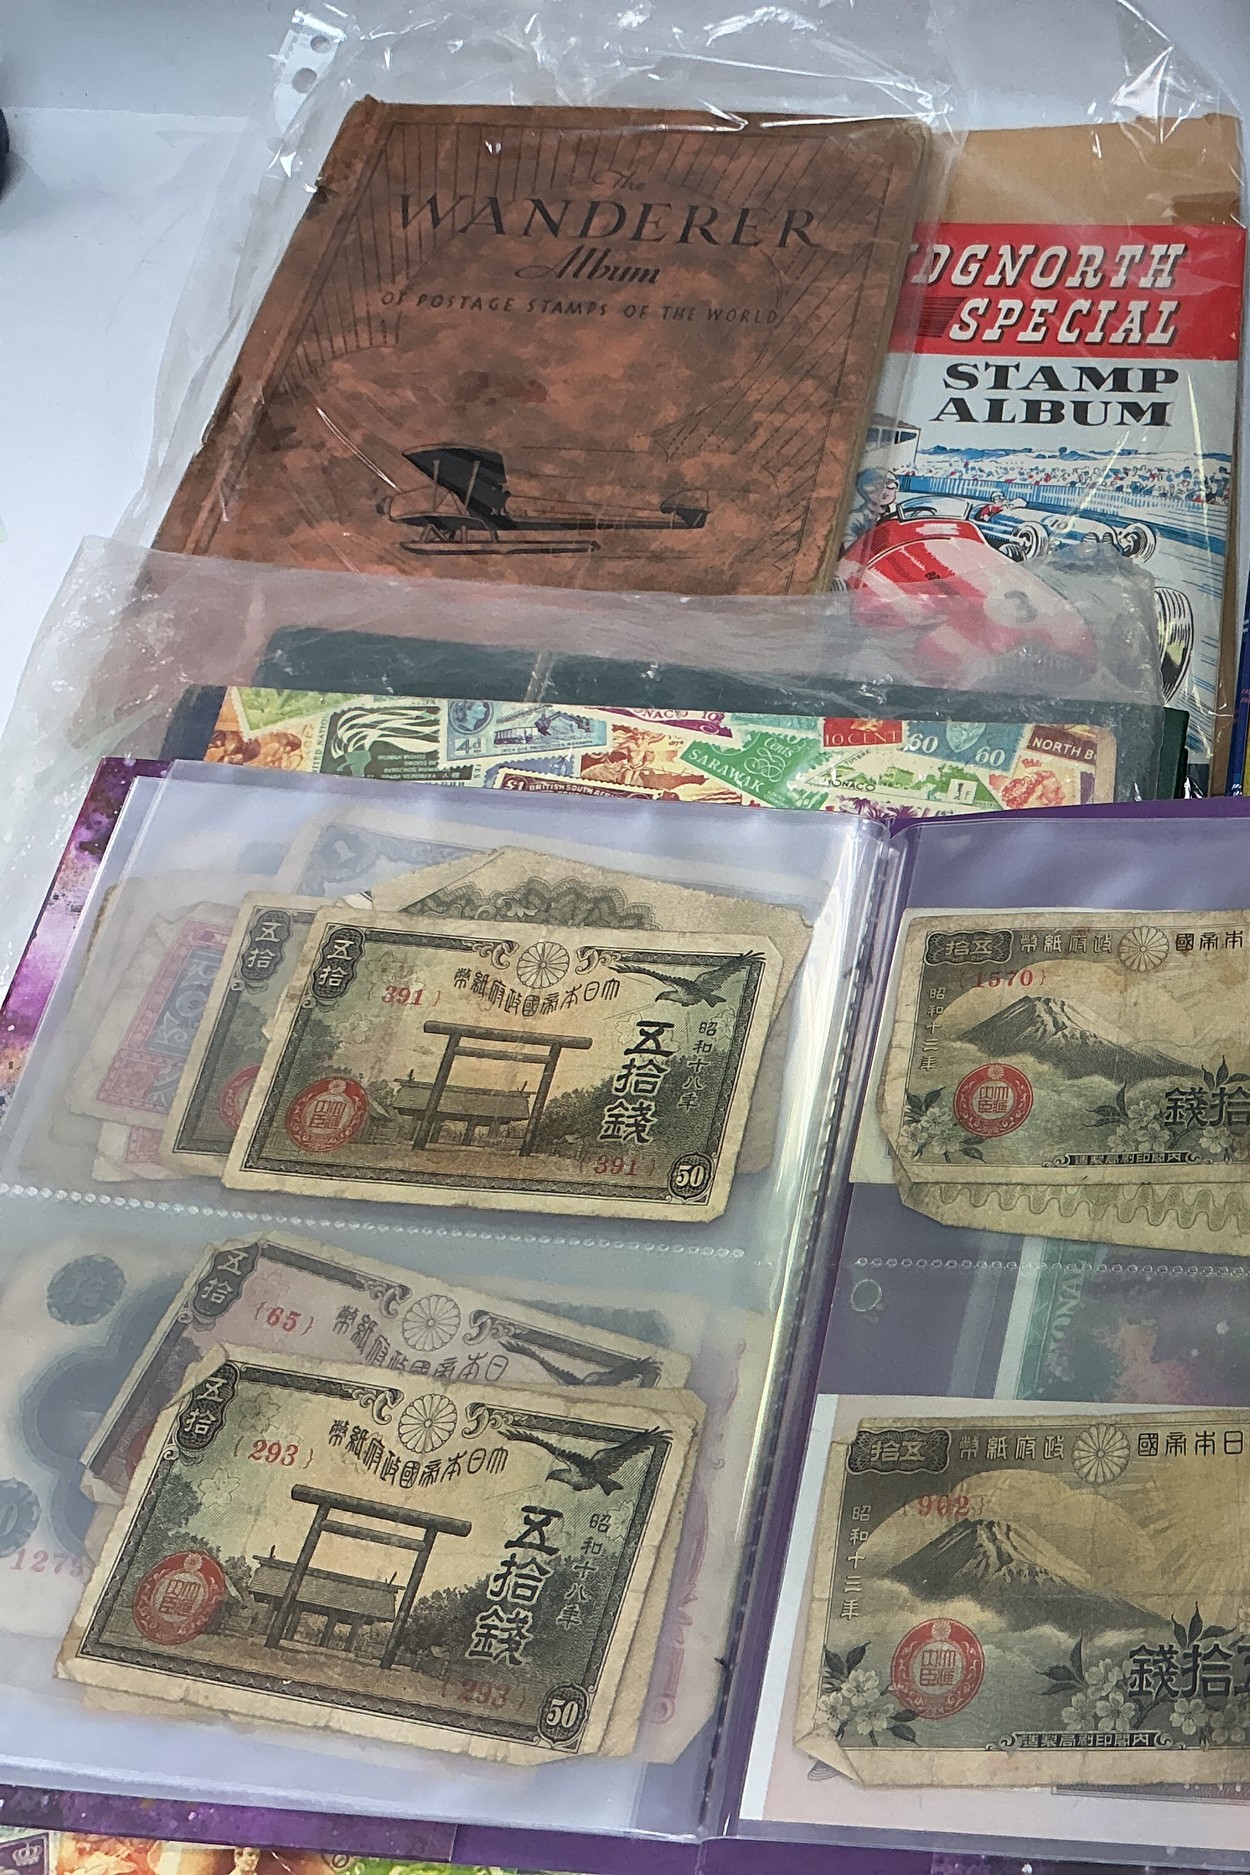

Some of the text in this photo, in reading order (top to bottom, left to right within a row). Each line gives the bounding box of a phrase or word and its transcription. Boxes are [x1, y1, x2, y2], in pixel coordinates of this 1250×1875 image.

[592, 170, 647, 193] The
[399, 194, 821, 248] WANDERER
[514, 245, 660, 285] Album
[381, 292, 780, 326] OF POSTAGE STAMPS OF THE WORLD
[949, 298, 1180, 345] SPECIAL
[942, 362, 1179, 394] STAMP
[930, 397, 1175, 427] ALBUM
[764, 737, 795, 758] Cents
[826, 734, 844, 746] 10
[908, 733, 939, 753] 60
[1032, 737, 1082, 757] NORTH
[844, 750, 871, 765] TIMBRE
[975, 746, 1006, 766] 60
[689, 749, 765, 792] SARAWAK
[529, 782, 565, 791] BRITISH
[565, 783, 593, 794] SOUTH
[316, 938, 356, 988] 五拾
[676, 1163, 705, 1188] 50
[546, 1698, 579, 1728] 50
